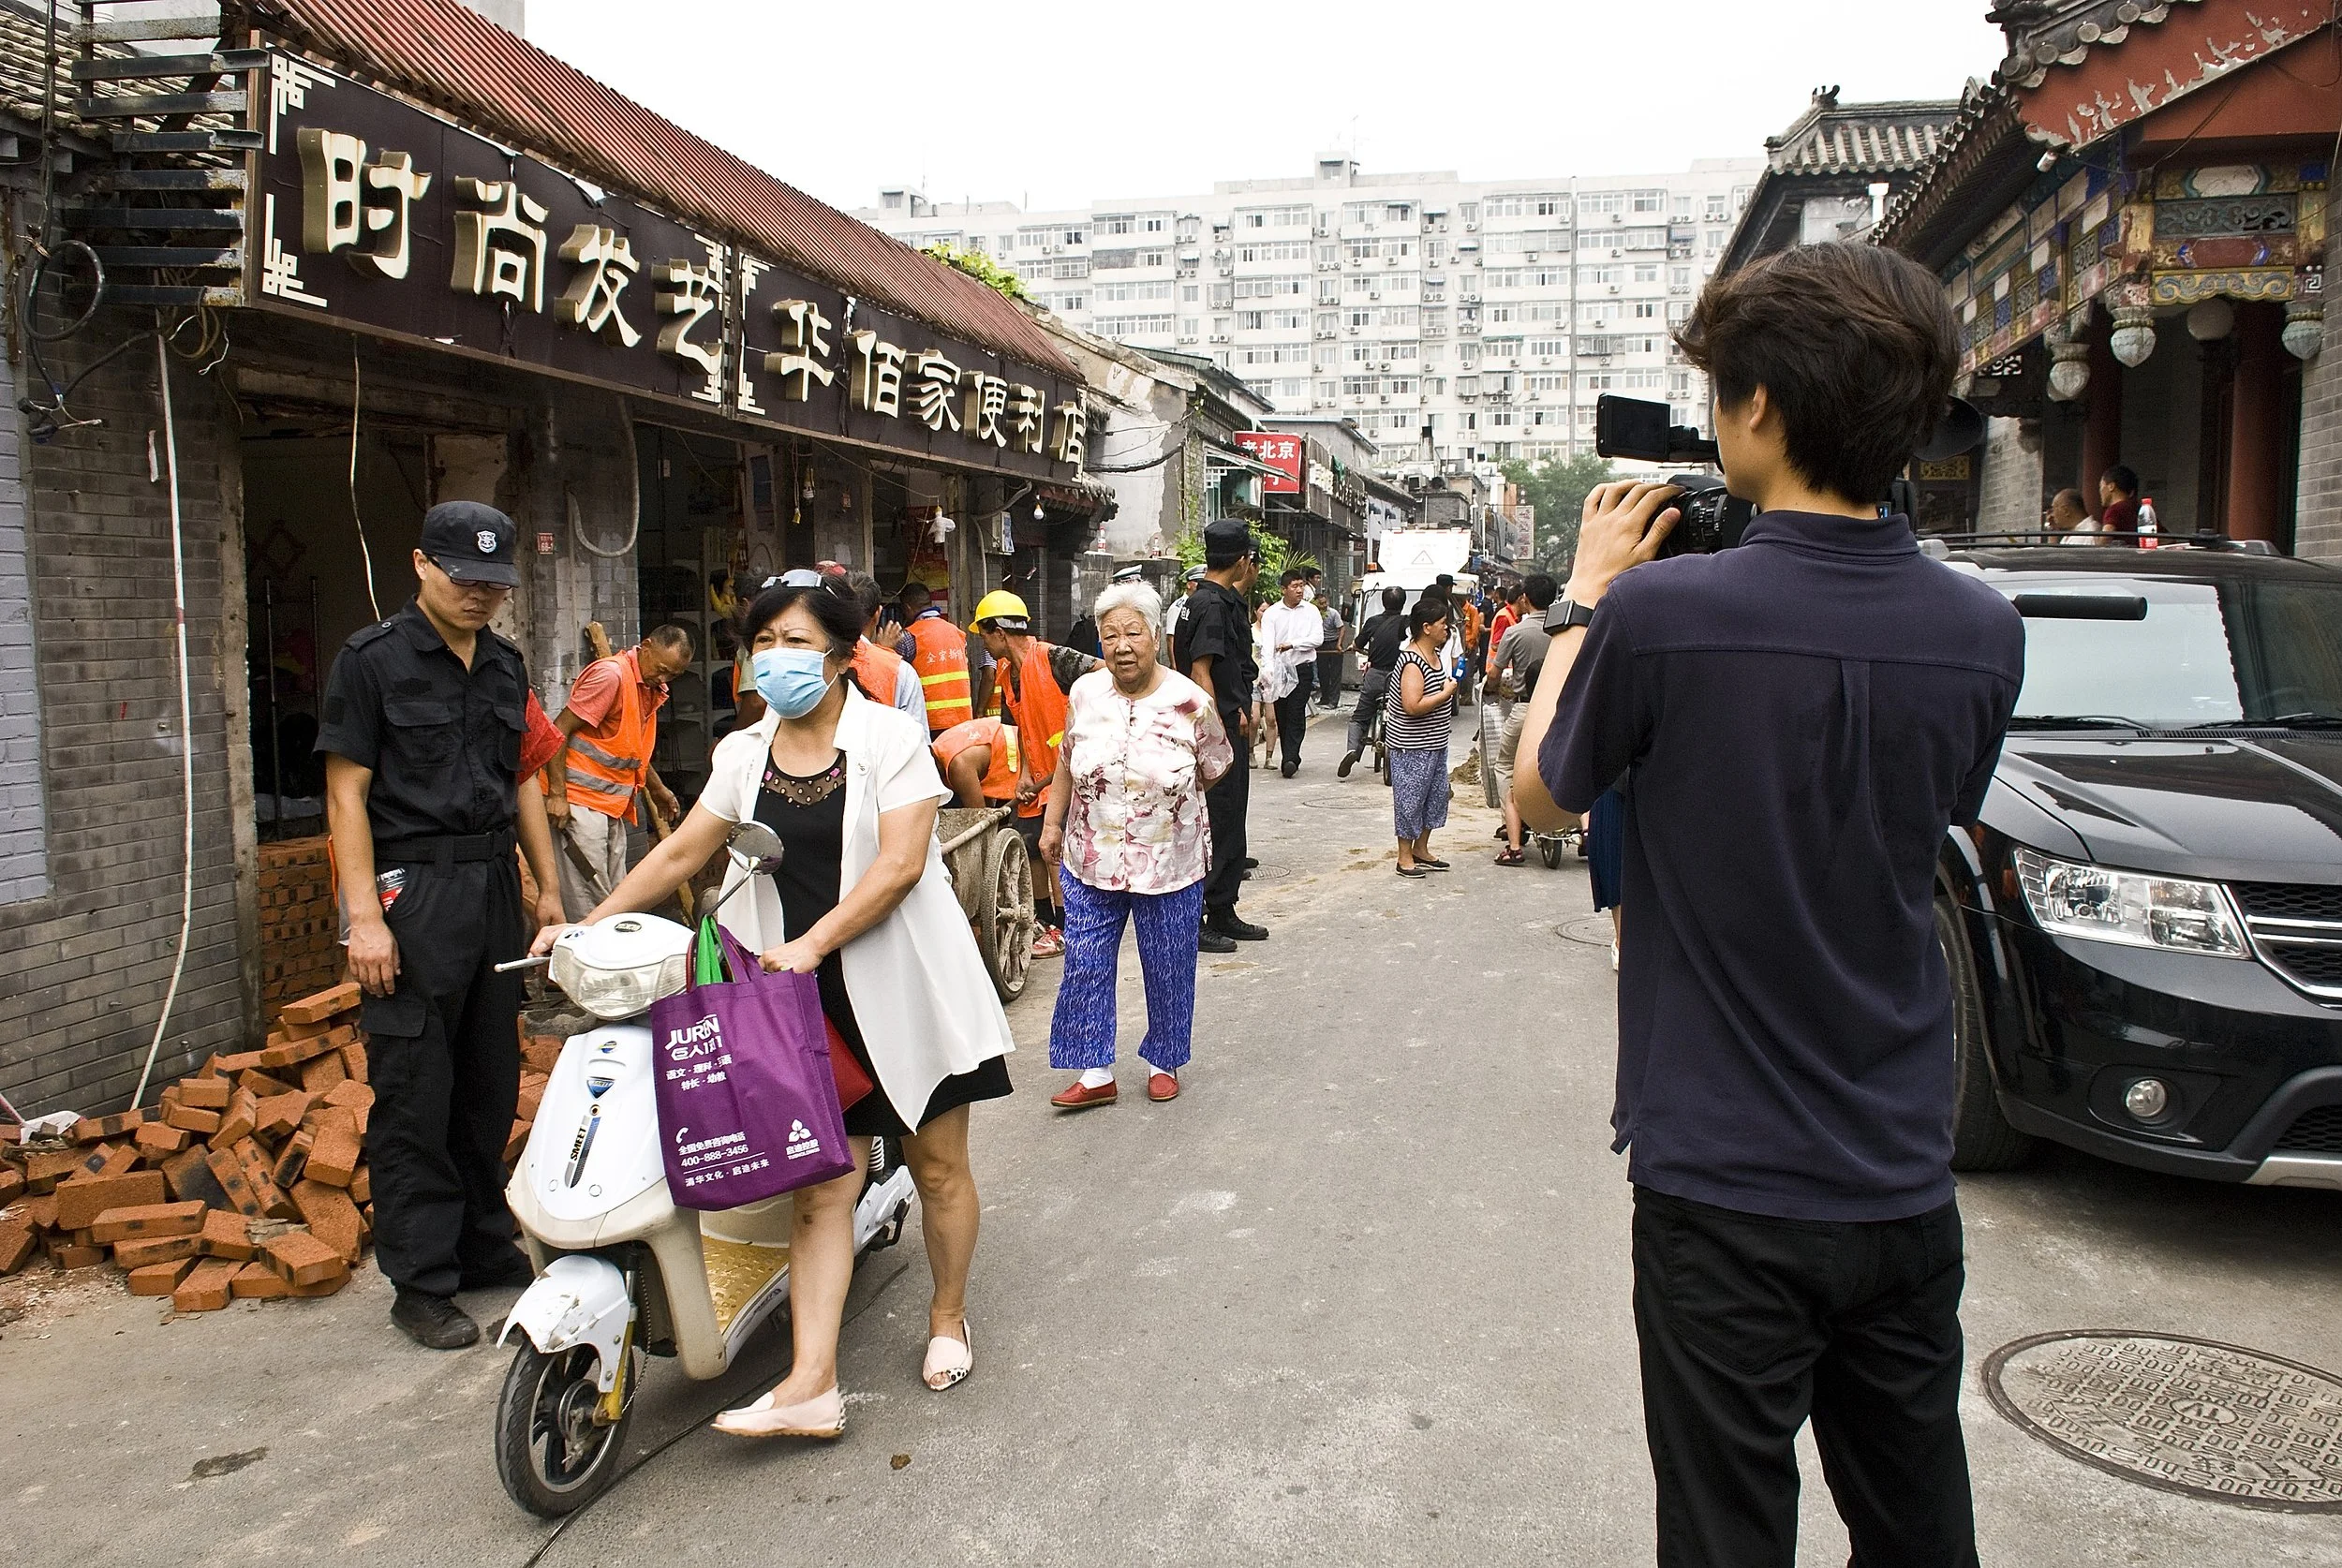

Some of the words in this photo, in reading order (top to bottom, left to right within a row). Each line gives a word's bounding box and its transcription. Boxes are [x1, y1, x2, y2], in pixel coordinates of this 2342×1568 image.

[297, 127, 725, 377] 时尚发艺
[764, 298, 1087, 465] 华佰家便利店
[571, 1127, 586, 1161] SMEET
[678, 1132, 746, 1155] 全国免费咨询电话
[681, 1145, 749, 1167] 400-888-3456
